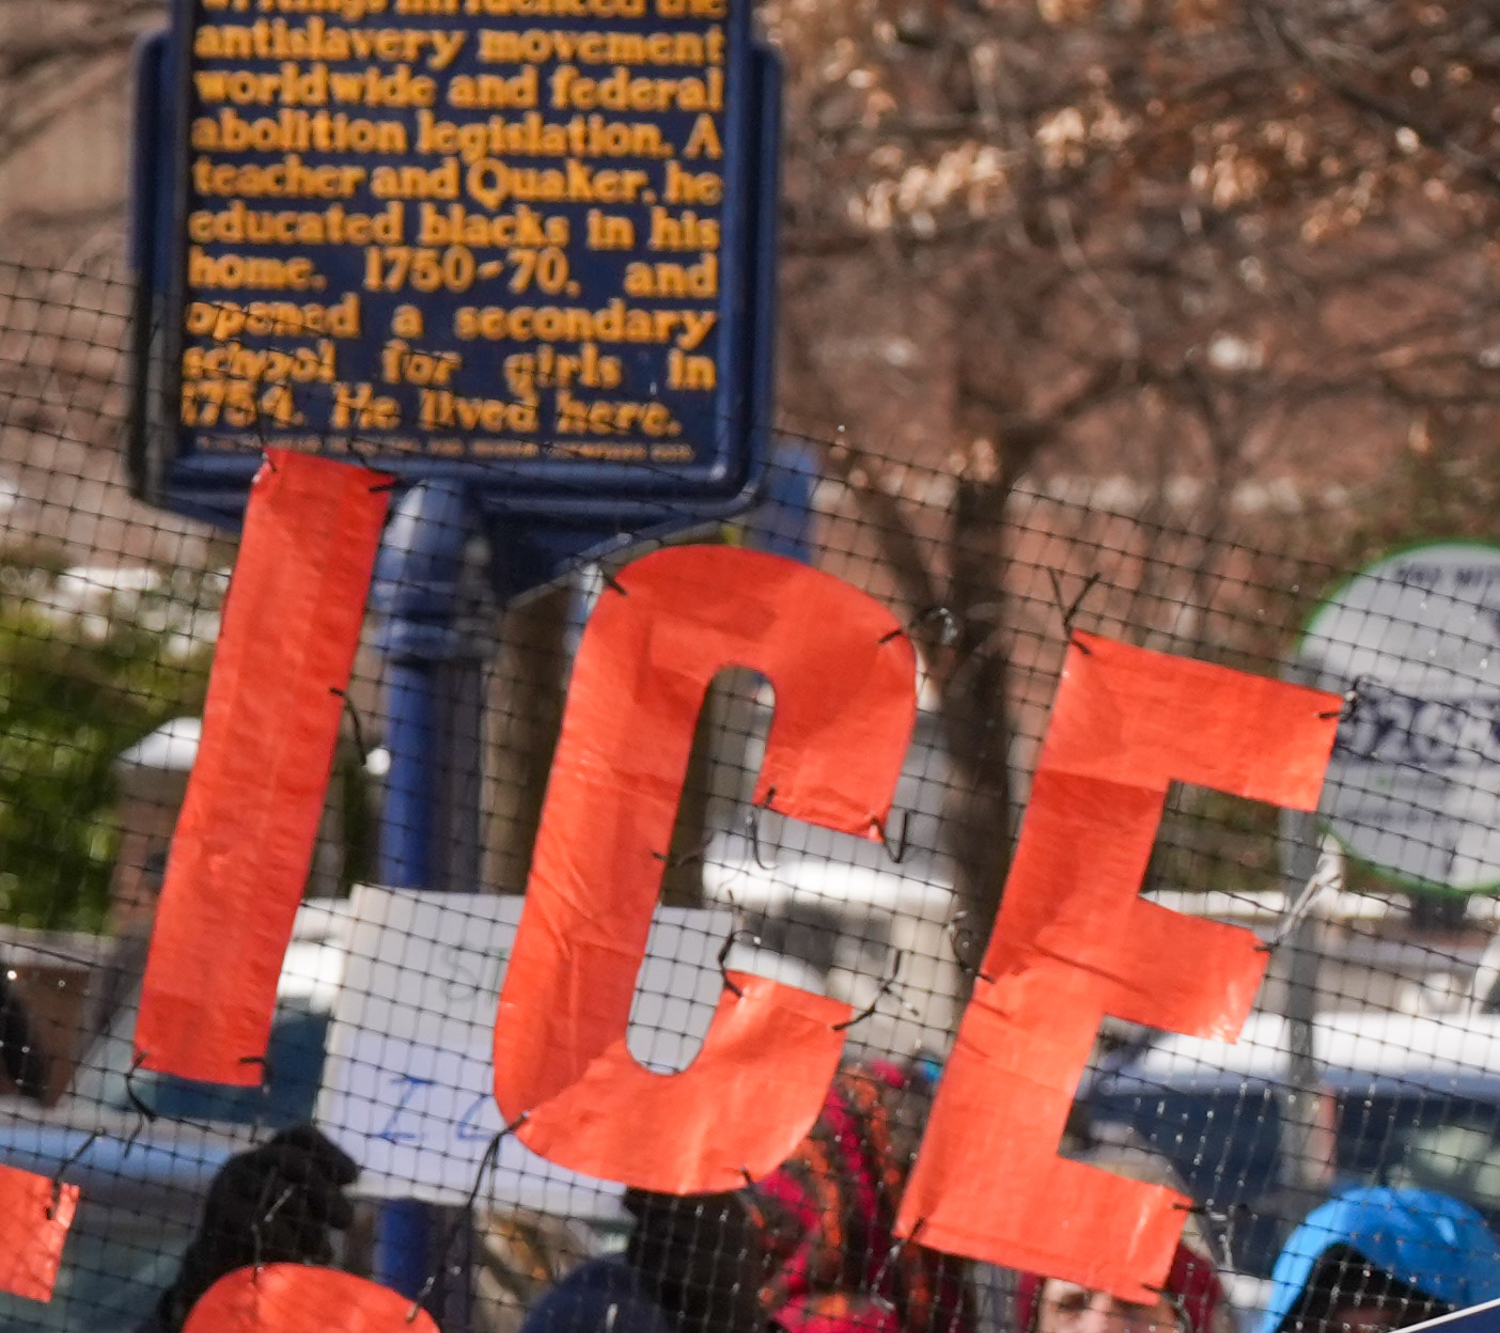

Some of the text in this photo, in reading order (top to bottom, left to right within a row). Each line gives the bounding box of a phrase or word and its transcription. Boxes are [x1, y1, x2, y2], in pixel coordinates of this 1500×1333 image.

[194, 16, 725, 69] antislavery movement
[194, 61, 723, 111] worldwide and federal
[191, 107, 408, 154] abolition
[683, 113, 722, 159] A
[192, 153, 366, 197] teacher
[370, 155, 460, 200] and
[664, 160, 722, 204] he
[189, 200, 721, 250] educated blacks in his
[623, 251, 718, 298] and
[186, 292, 717, 349] opened a secondary
[182, 338, 717, 406] school for girls in
[330, 381, 400, 430] He
[419, 389, 539, 433] lived
[555, 390, 683, 437] here.
[133, 448, 1343, 1305] ICE
